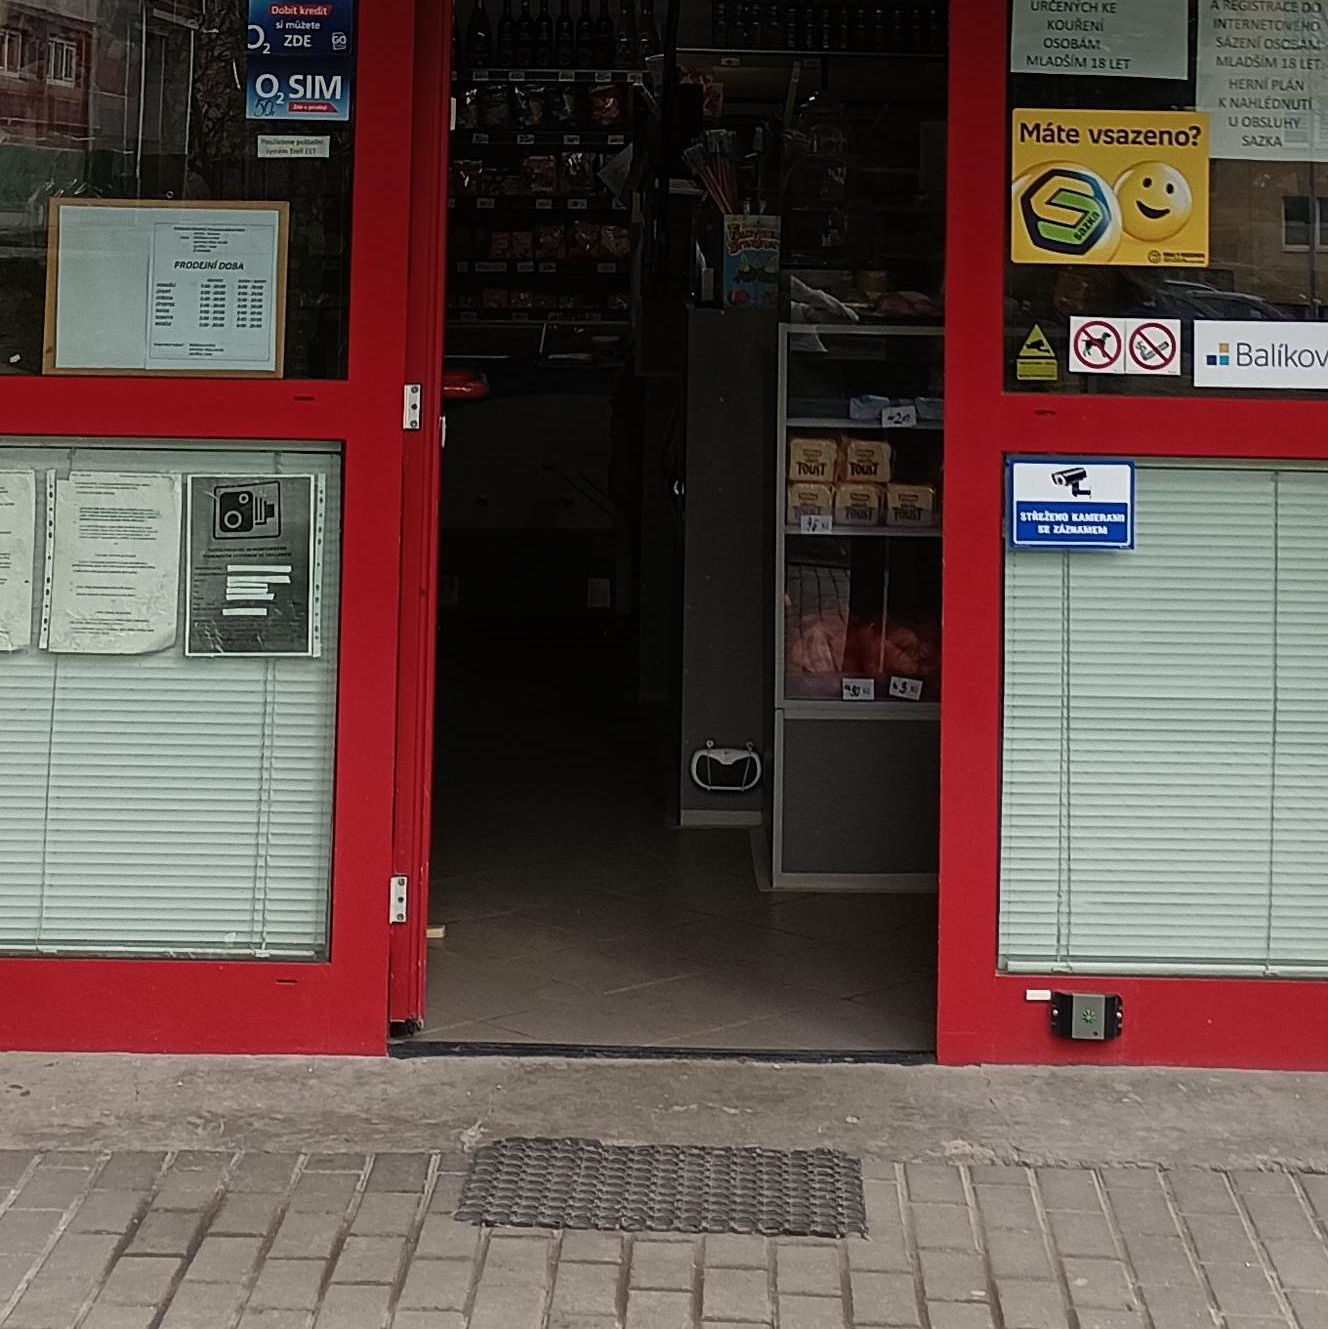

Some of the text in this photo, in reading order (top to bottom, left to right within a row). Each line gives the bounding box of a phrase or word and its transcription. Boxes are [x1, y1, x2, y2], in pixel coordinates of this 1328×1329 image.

[299, 6, 328, 16] kredit
[1031, 0, 1117, 13] URČENÝCH KE
[1210, 0, 1322, 13] A REGISTRACE DO
[1047, 18, 1104, 31] KOUŘENÍ
[283, 34, 312, 47] ZDE
[1043, 37, 1102, 50] OSOBÁM
[1215, 35, 1261, 49] SÁZENÍ
[1026, 55, 1131, 70] MLADŠÍM 18 LET
[1216, 54, 1277, 68] MLADŠÍM
[1282, 57, 1296, 69] 18
[289, 74, 342, 99] SIM
[1228, 77, 1304, 91] HERNÍ PLÁN
[1218, 95, 1312, 110] K NAHLÉDNUTÍ
[1228, 116, 1301, 129] U OBSLUHY
[1020, 121, 1202, 146] Máte vsazeno?
[1242, 135, 1282, 147] SAZKA
[174, 260, 244, 270] PRODEJNÍ DOBA
